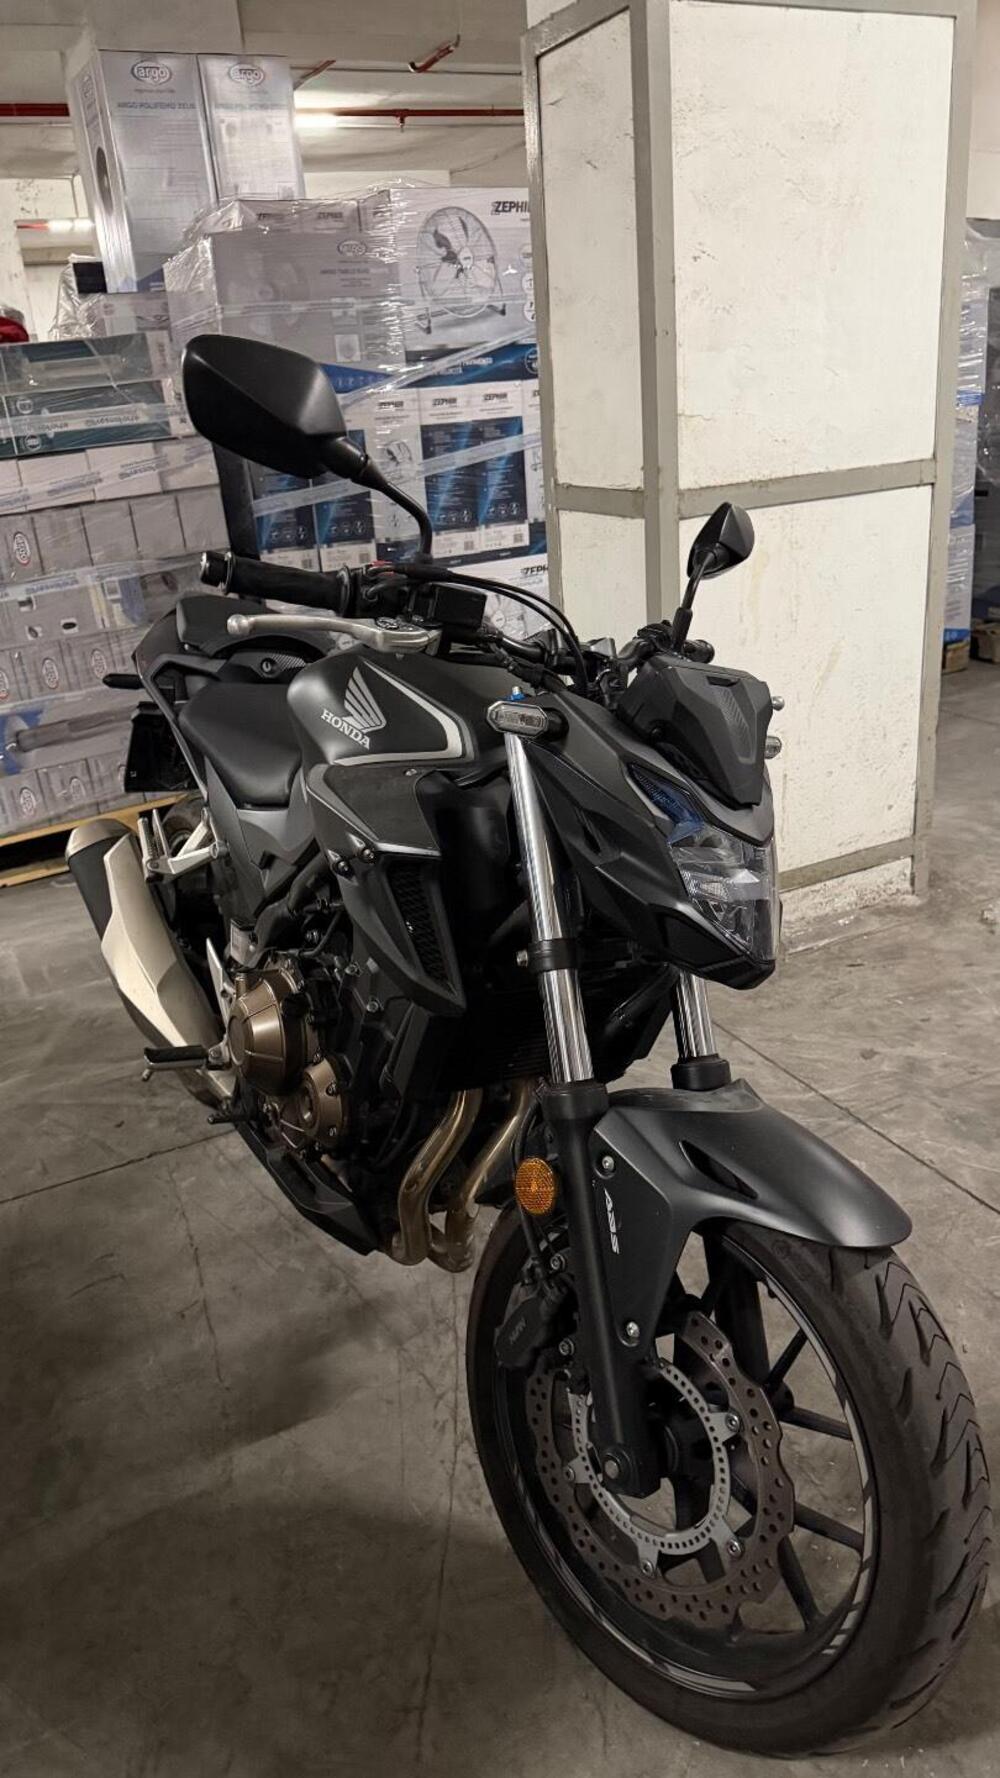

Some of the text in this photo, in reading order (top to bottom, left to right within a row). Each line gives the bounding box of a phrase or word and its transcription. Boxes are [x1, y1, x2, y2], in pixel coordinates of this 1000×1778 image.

[137, 67, 168, 83] argo
[232, 69, 263, 84] argo
[494, 200, 530, 213] ZEPHI
[523, 565, 548, 575] ZEPH
[321, 709, 370, 750] HONDA
[604, 1187, 619, 1254] ABS
